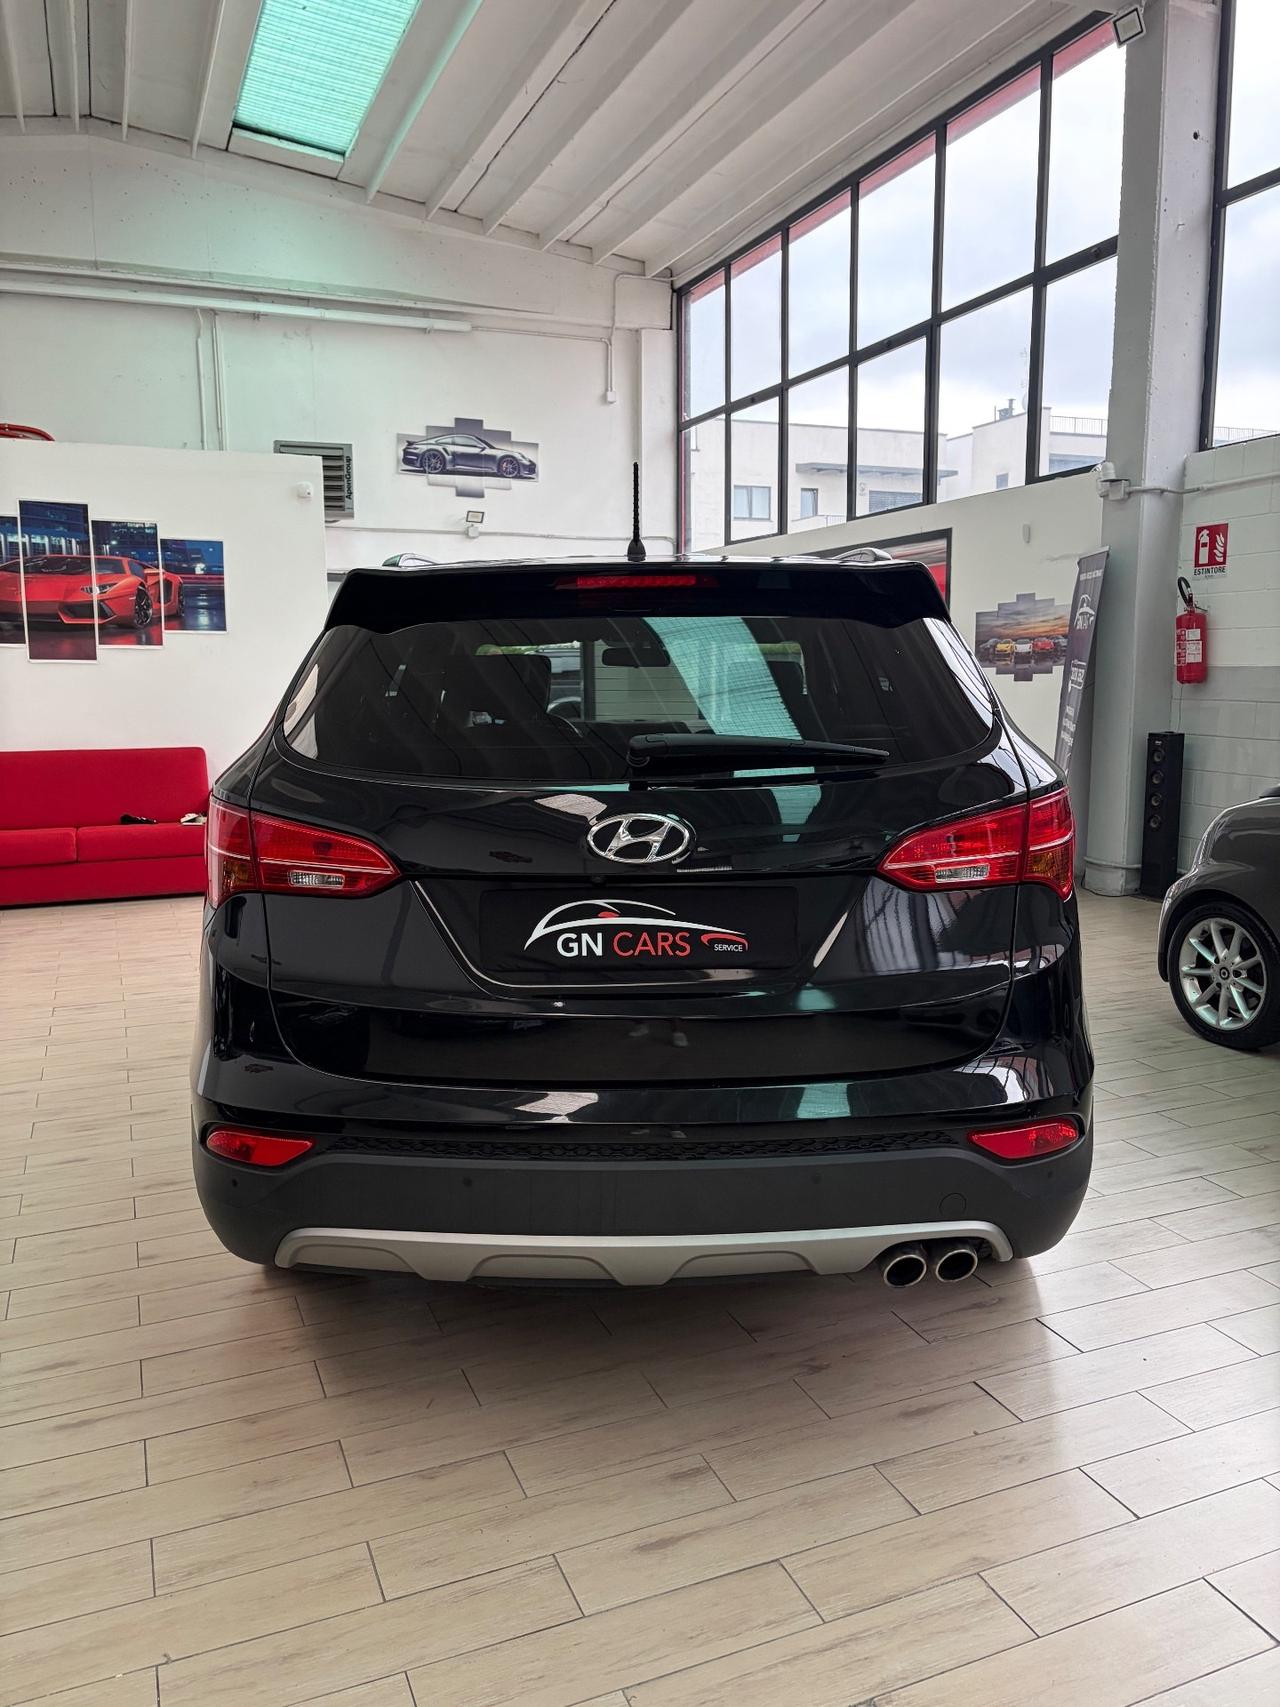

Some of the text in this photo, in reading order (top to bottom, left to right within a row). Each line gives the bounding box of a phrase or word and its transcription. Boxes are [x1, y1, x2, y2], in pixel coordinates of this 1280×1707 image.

[1194, 566, 1226, 576] ESTINTORE
[556, 932, 691, 957] GN CARS
[713, 943, 743, 952] SERVICE
